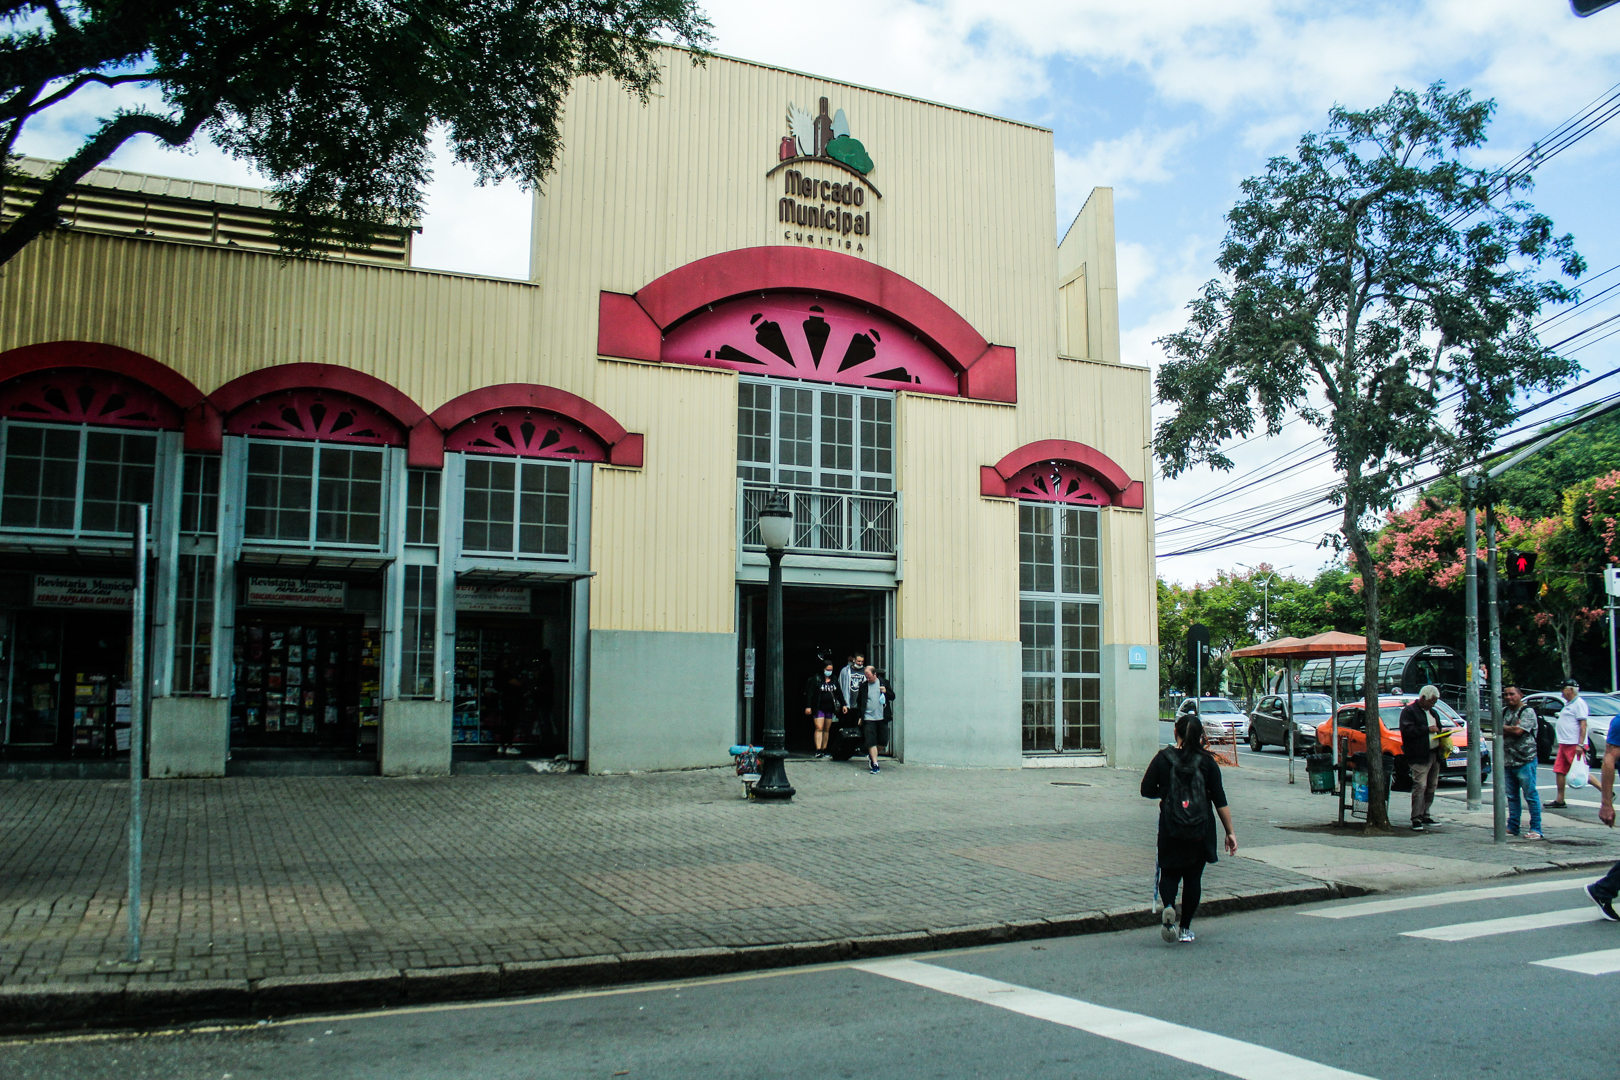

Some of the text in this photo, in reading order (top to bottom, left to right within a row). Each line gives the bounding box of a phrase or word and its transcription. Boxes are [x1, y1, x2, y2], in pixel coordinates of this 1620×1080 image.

[785, 169, 864, 206] Mercado
[779, 197, 870, 236] Municipal
[785, 230, 864, 252] CURITIBA
[37, 577, 135, 593] Revistaria Municip
[66, 588, 112, 596] TABACARIA
[251, 577, 343, 591] Revistaria Municipal
[37, 594, 58, 602] XEROX
[60, 595, 94, 604] PAPELARIA
